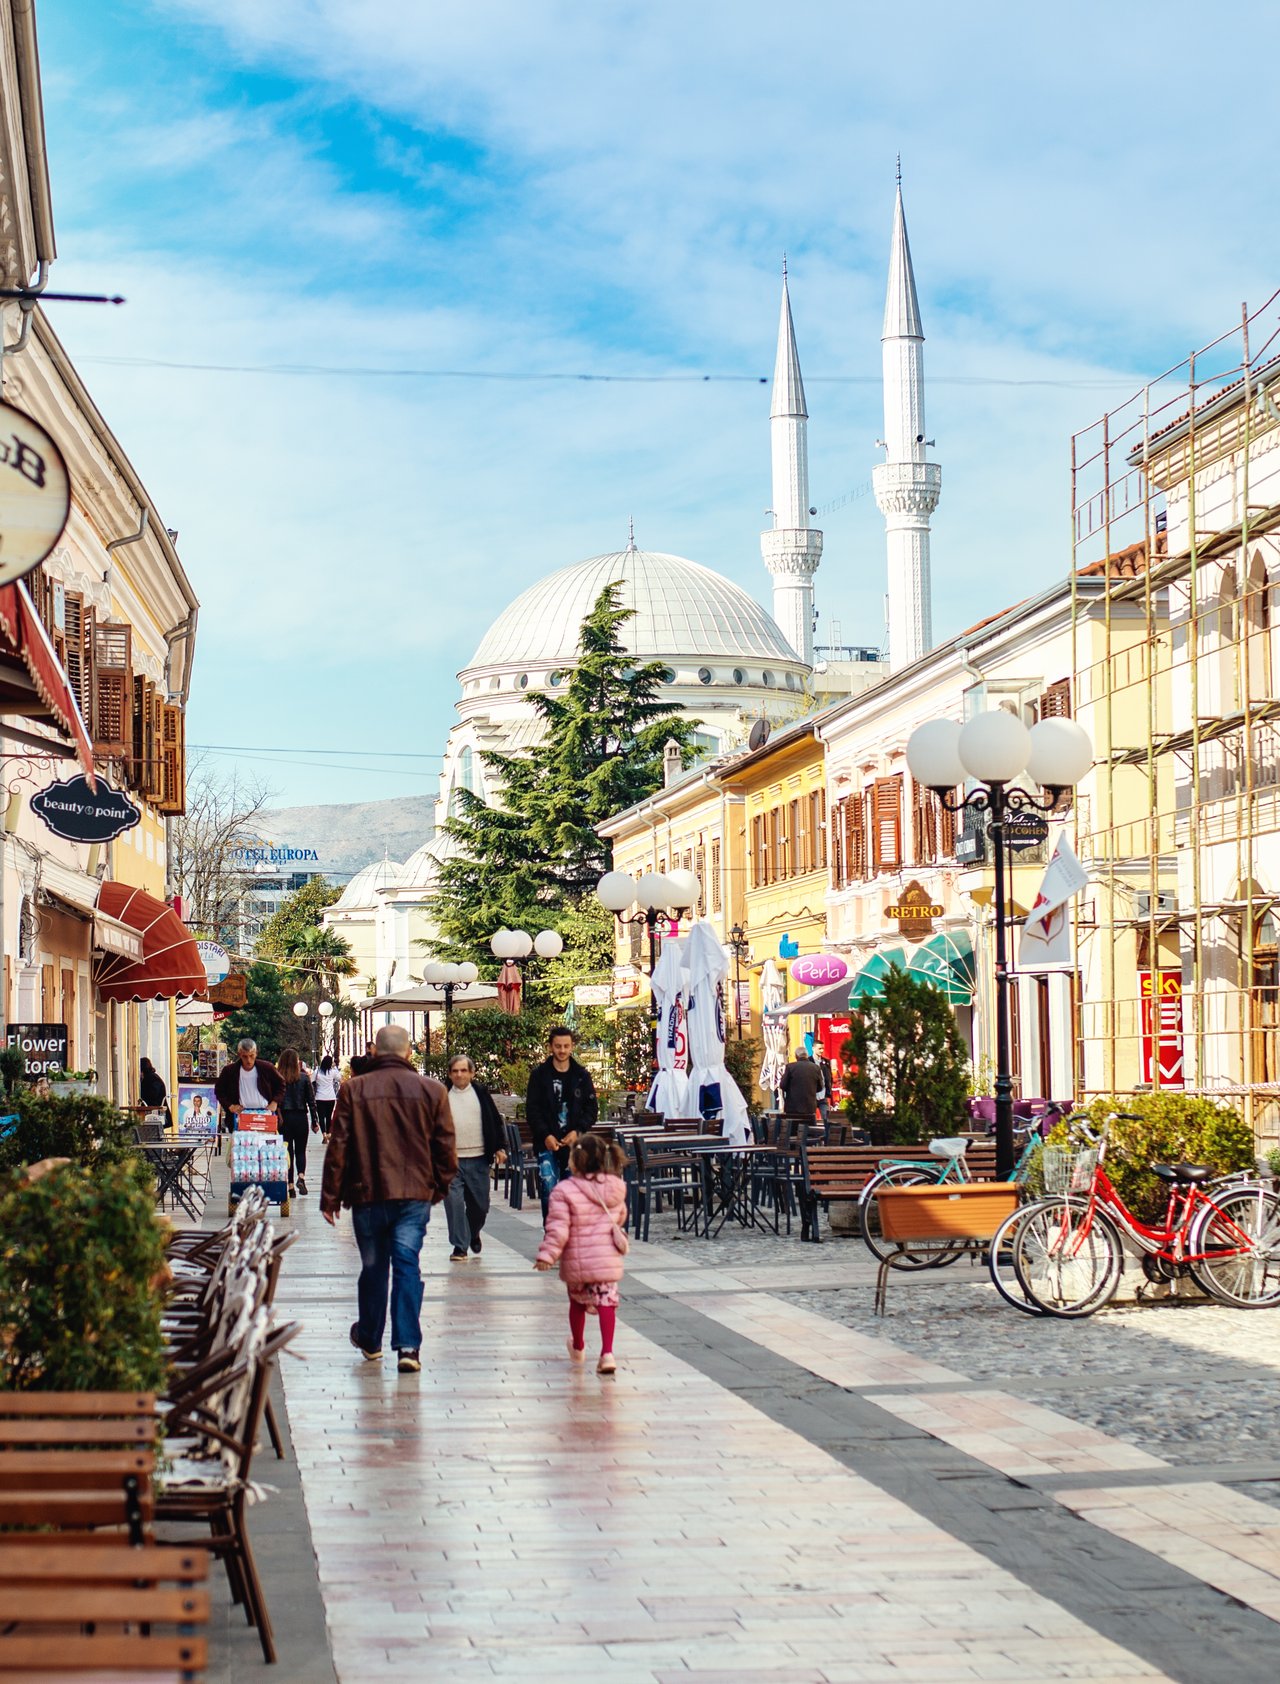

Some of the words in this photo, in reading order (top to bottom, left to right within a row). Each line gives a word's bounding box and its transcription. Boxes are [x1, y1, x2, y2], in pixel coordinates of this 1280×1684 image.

[43, 797, 84, 814] beauty
[95, 807, 126, 819] point
[1014, 826, 1048, 835] COHEN
[270, 849, 319, 860] EUROPA
[889, 906, 942, 918] RETRO
[798, 961, 840, 979] Perla
[7, 1034, 67, 1052] Flower
[24, 1058, 60, 1075] tore
